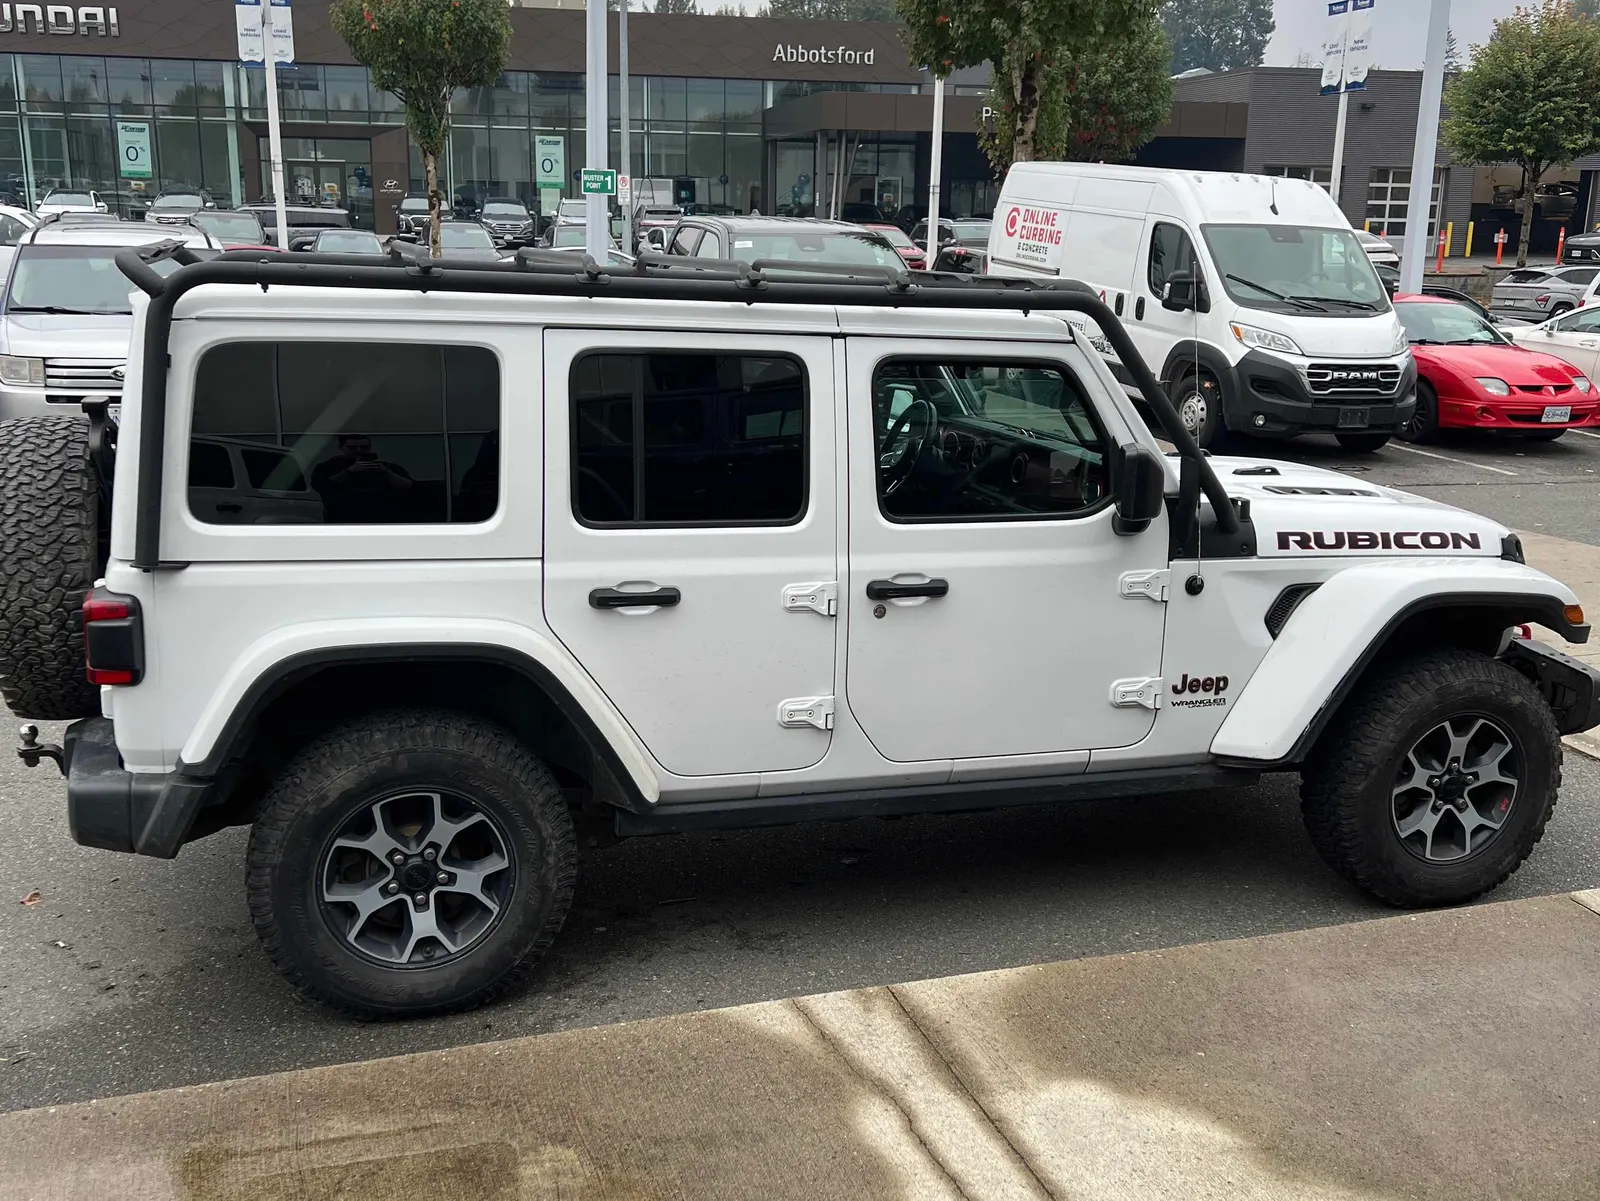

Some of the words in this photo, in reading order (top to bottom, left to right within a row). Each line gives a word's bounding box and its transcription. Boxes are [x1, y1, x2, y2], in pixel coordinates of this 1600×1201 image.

[773, 43, 874, 65] Abbotsford
[605, 175, 611, 190] 1
[1022, 208, 1058, 227] ONLINE
[1019, 225, 1062, 245] CURBING
[1021, 242, 1048, 255] CONCRETE
[1332, 371, 1377, 380] RAM
[1276, 531, 1481, 550] RUBICON
[1171, 673, 1229, 696] Jeep
[1171, 697, 1226, 707] WRANGLER
